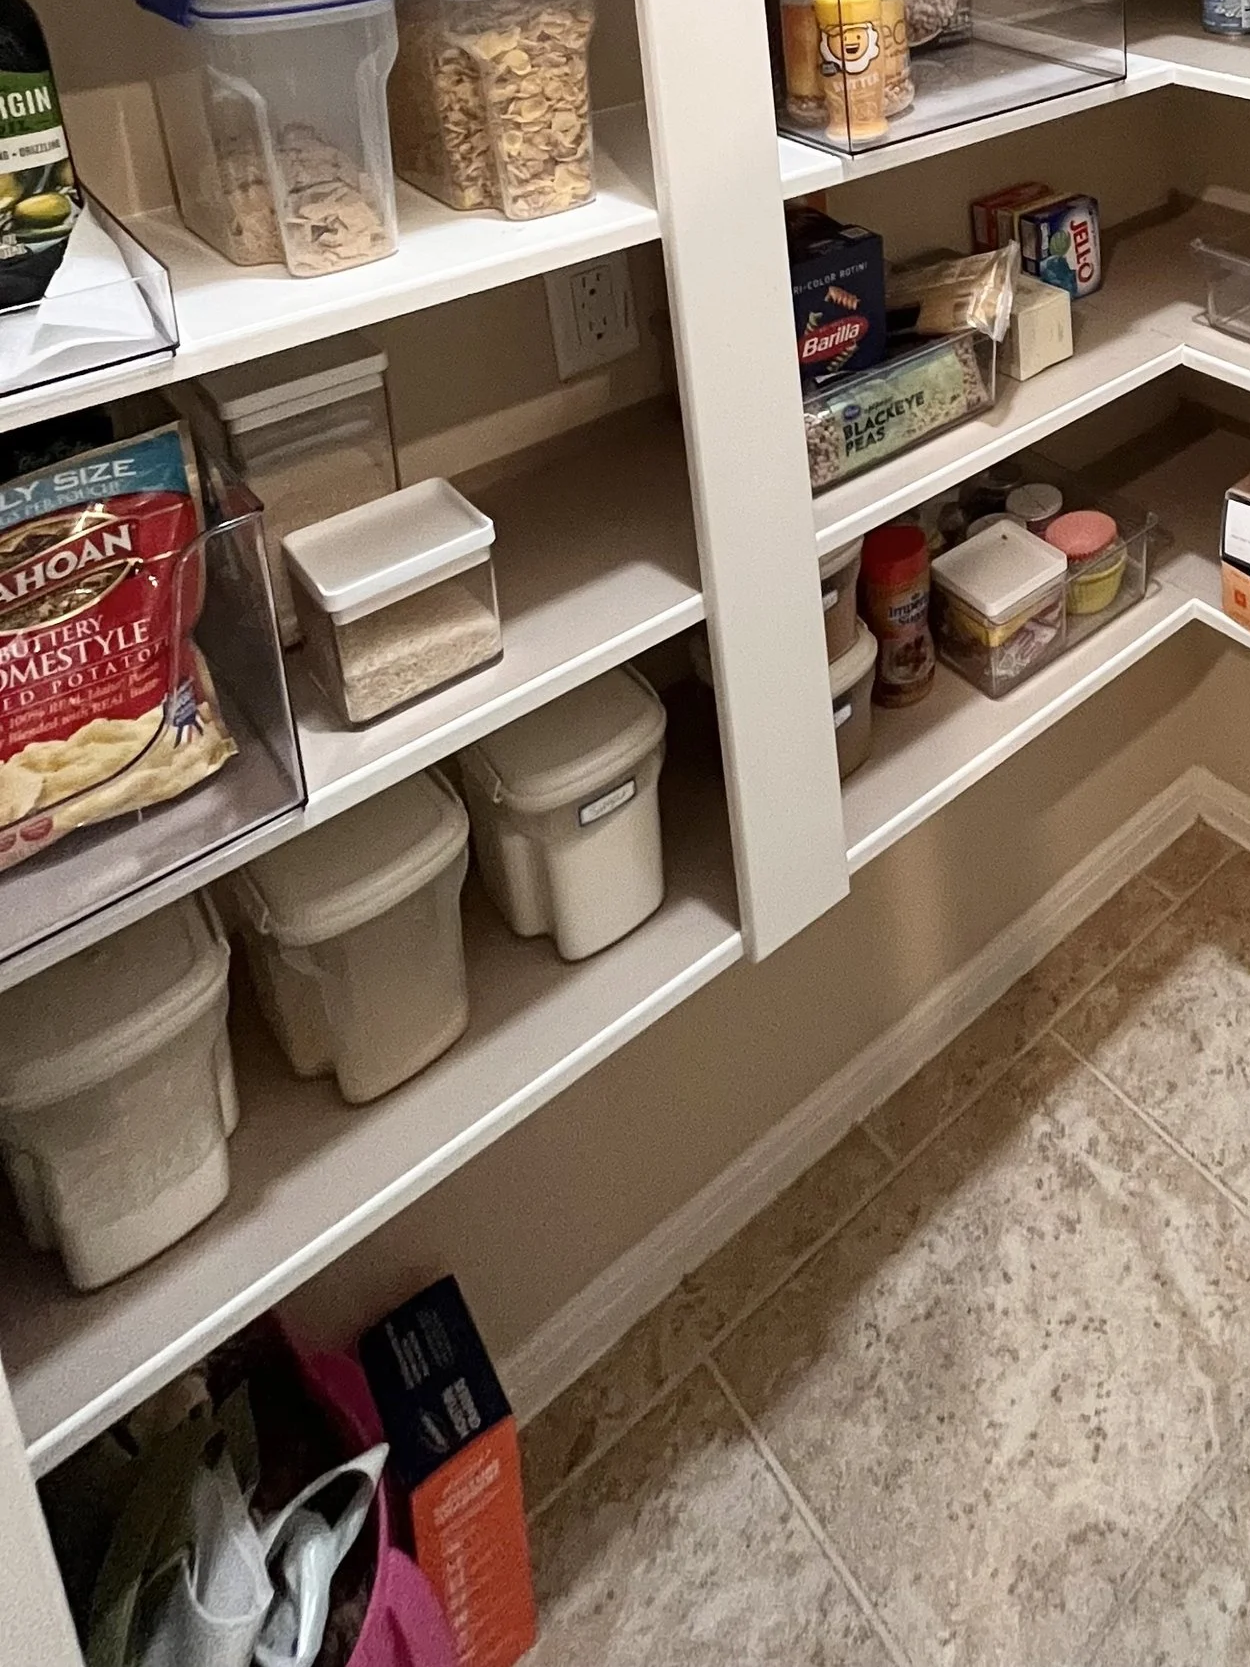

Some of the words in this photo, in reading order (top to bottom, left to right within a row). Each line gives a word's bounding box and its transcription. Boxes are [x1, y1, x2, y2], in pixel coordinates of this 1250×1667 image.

[793, 272, 837, 295] RI-COLOR
[839, 260, 868, 279] ROTINI
[802, 322, 861, 359] Barilla
[842, 390, 926, 441] BLACKEYE
[845, 425, 886, 458] PEAS
[53, 458, 137, 492] SIZE
[0, 615, 105, 664] BUTTERY
